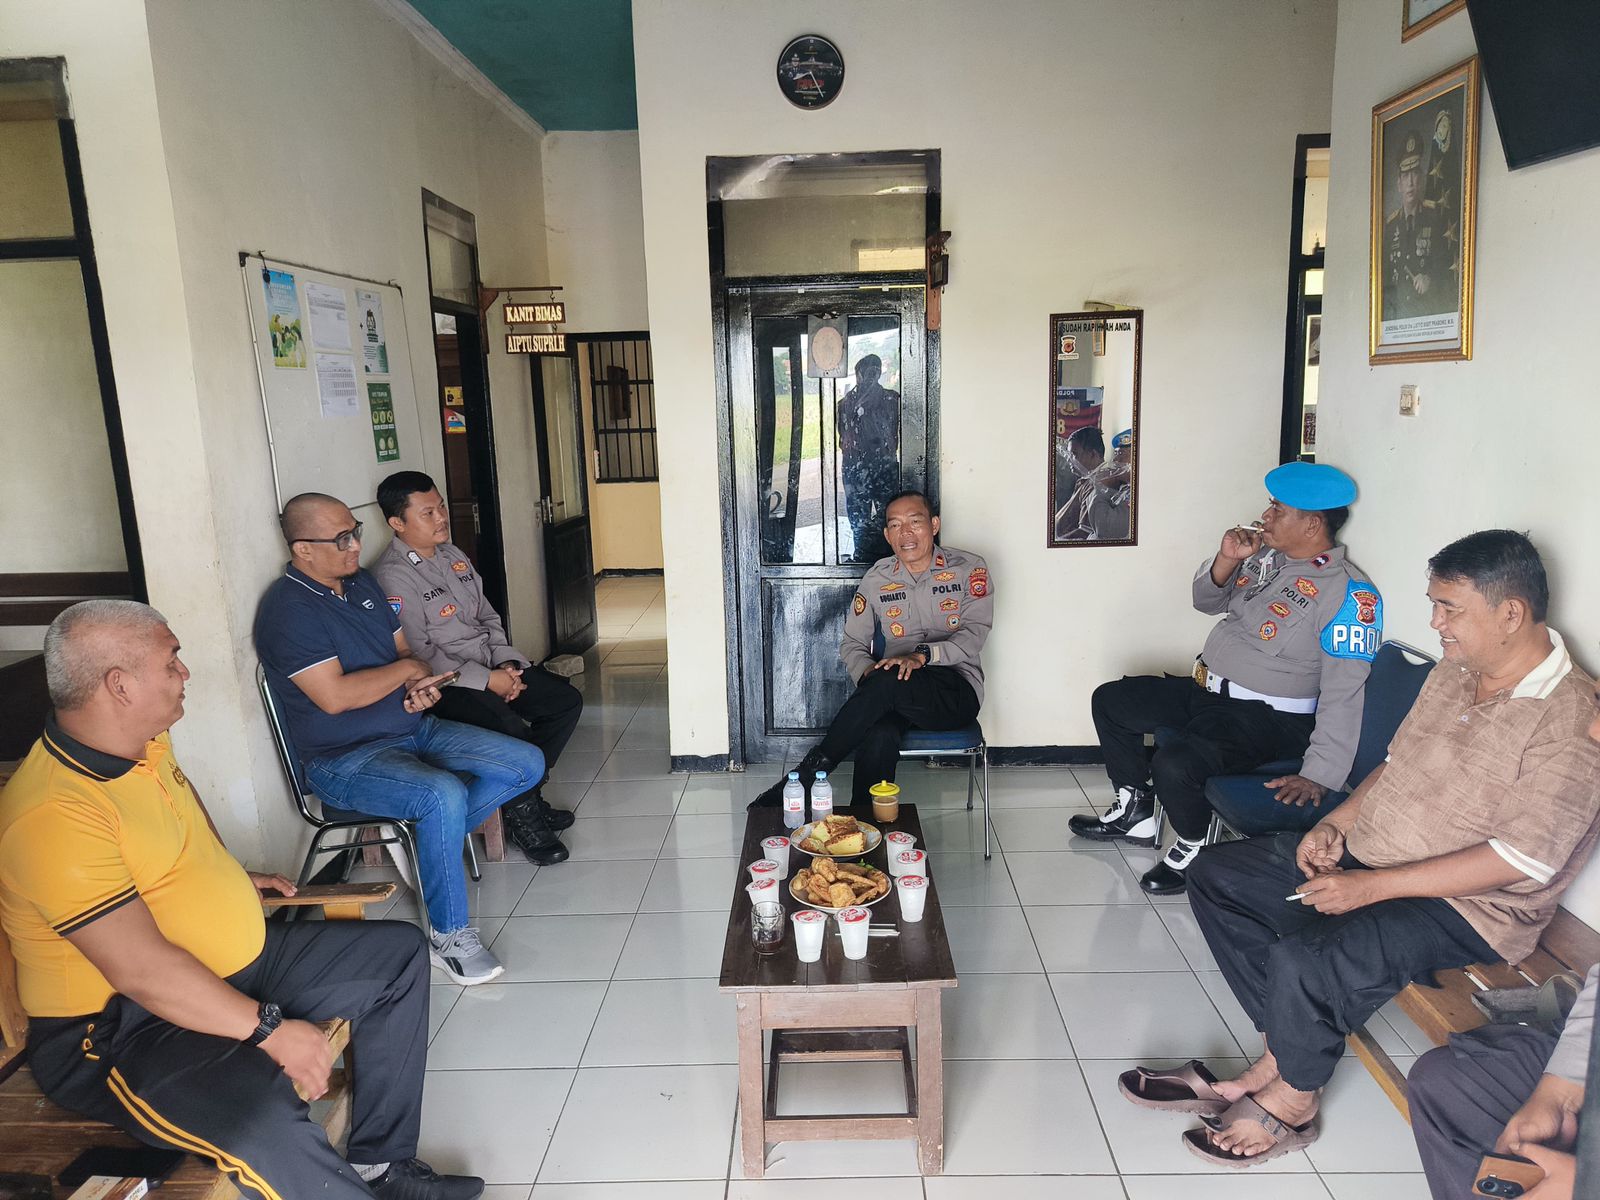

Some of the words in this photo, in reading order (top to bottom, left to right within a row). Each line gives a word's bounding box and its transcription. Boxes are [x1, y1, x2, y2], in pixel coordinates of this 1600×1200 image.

[506, 306, 534, 322] KANIT
[535, 305, 562, 321] BIMAS
[1062, 322, 1082, 333] SUDAH
[1114, 321, 1131, 332] ANDA
[932, 583, 962, 595] POLRI
[1280, 586, 1309, 609] POLRI
[1332, 624, 1380, 655] PRO
